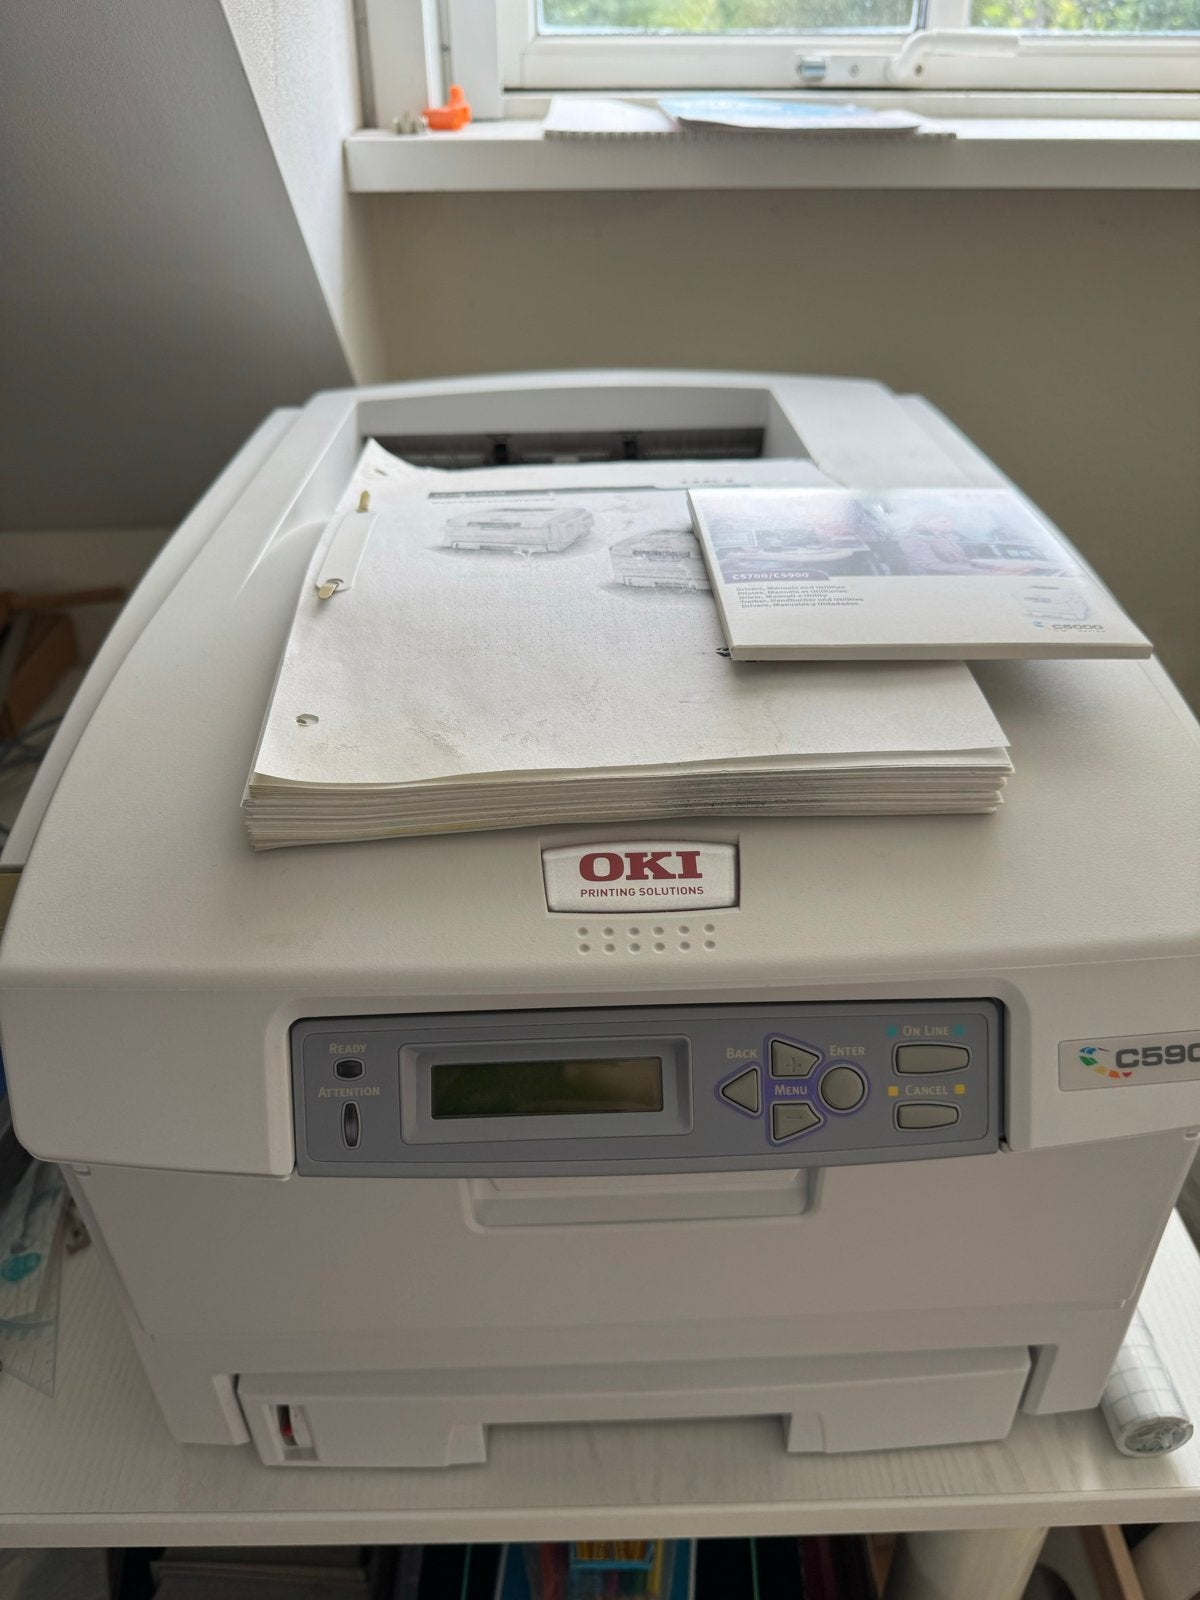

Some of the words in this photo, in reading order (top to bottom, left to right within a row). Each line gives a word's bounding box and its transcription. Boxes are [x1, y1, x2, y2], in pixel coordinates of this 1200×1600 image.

[579, 850, 703, 882] OKI
[580, 887, 636, 898] PRINTING
[639, 886, 704, 897] SOLUTIONS
[903, 1025, 921, 1036] ON
[924, 1024, 950, 1036] LINE
[329, 1042, 367, 1055] READY
[726, 1047, 758, 1059] BACK
[829, 1044, 866, 1056] ENTER
[318, 1085, 380, 1098] ATTENTION
[774, 1084, 808, 1096] MENU
[905, 1084, 948, 1096] CANCEL
